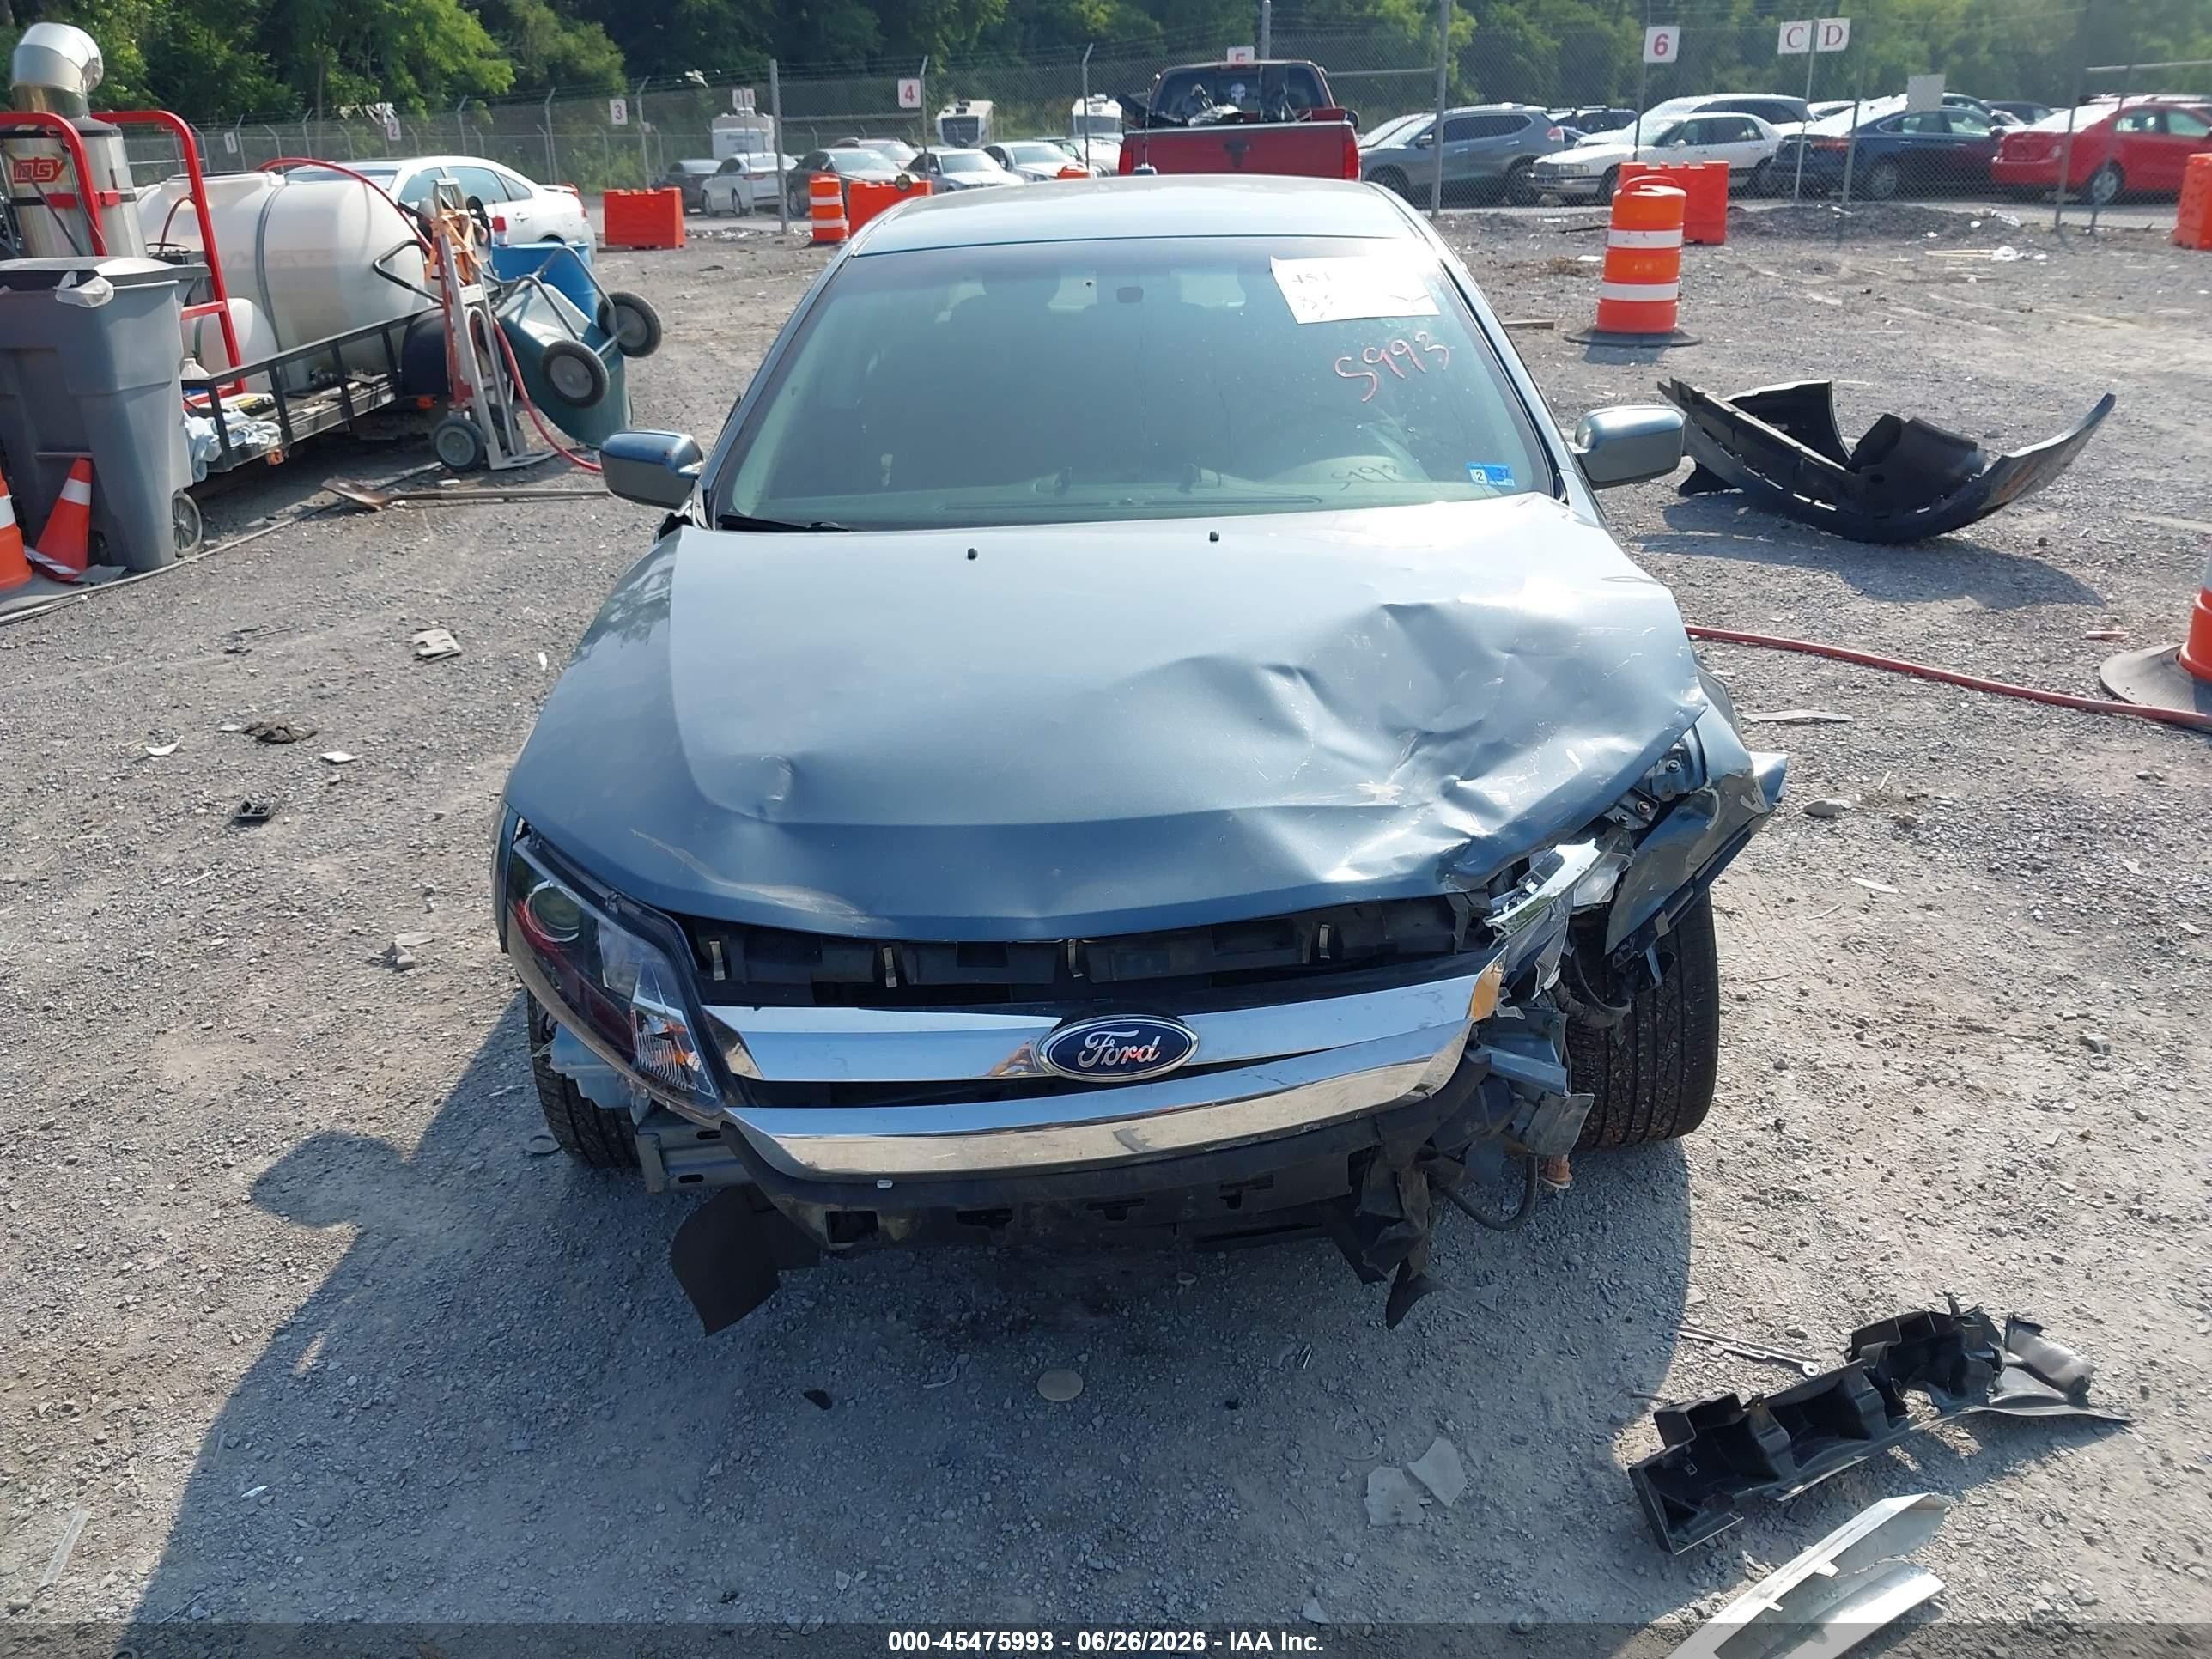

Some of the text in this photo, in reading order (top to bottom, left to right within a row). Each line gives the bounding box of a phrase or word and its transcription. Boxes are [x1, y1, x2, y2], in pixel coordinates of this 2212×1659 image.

[1653, 33, 1669, 56] 6
[1786, 27, 1804, 49] C
[1825, 24, 1843, 46] D
[904, 84, 915, 102] 4
[615, 104, 623, 120] 3
[390, 122, 398, 137] 2
[1476, 471, 1485, 482] 2
[1077, 1030, 1162, 1068] Ford
